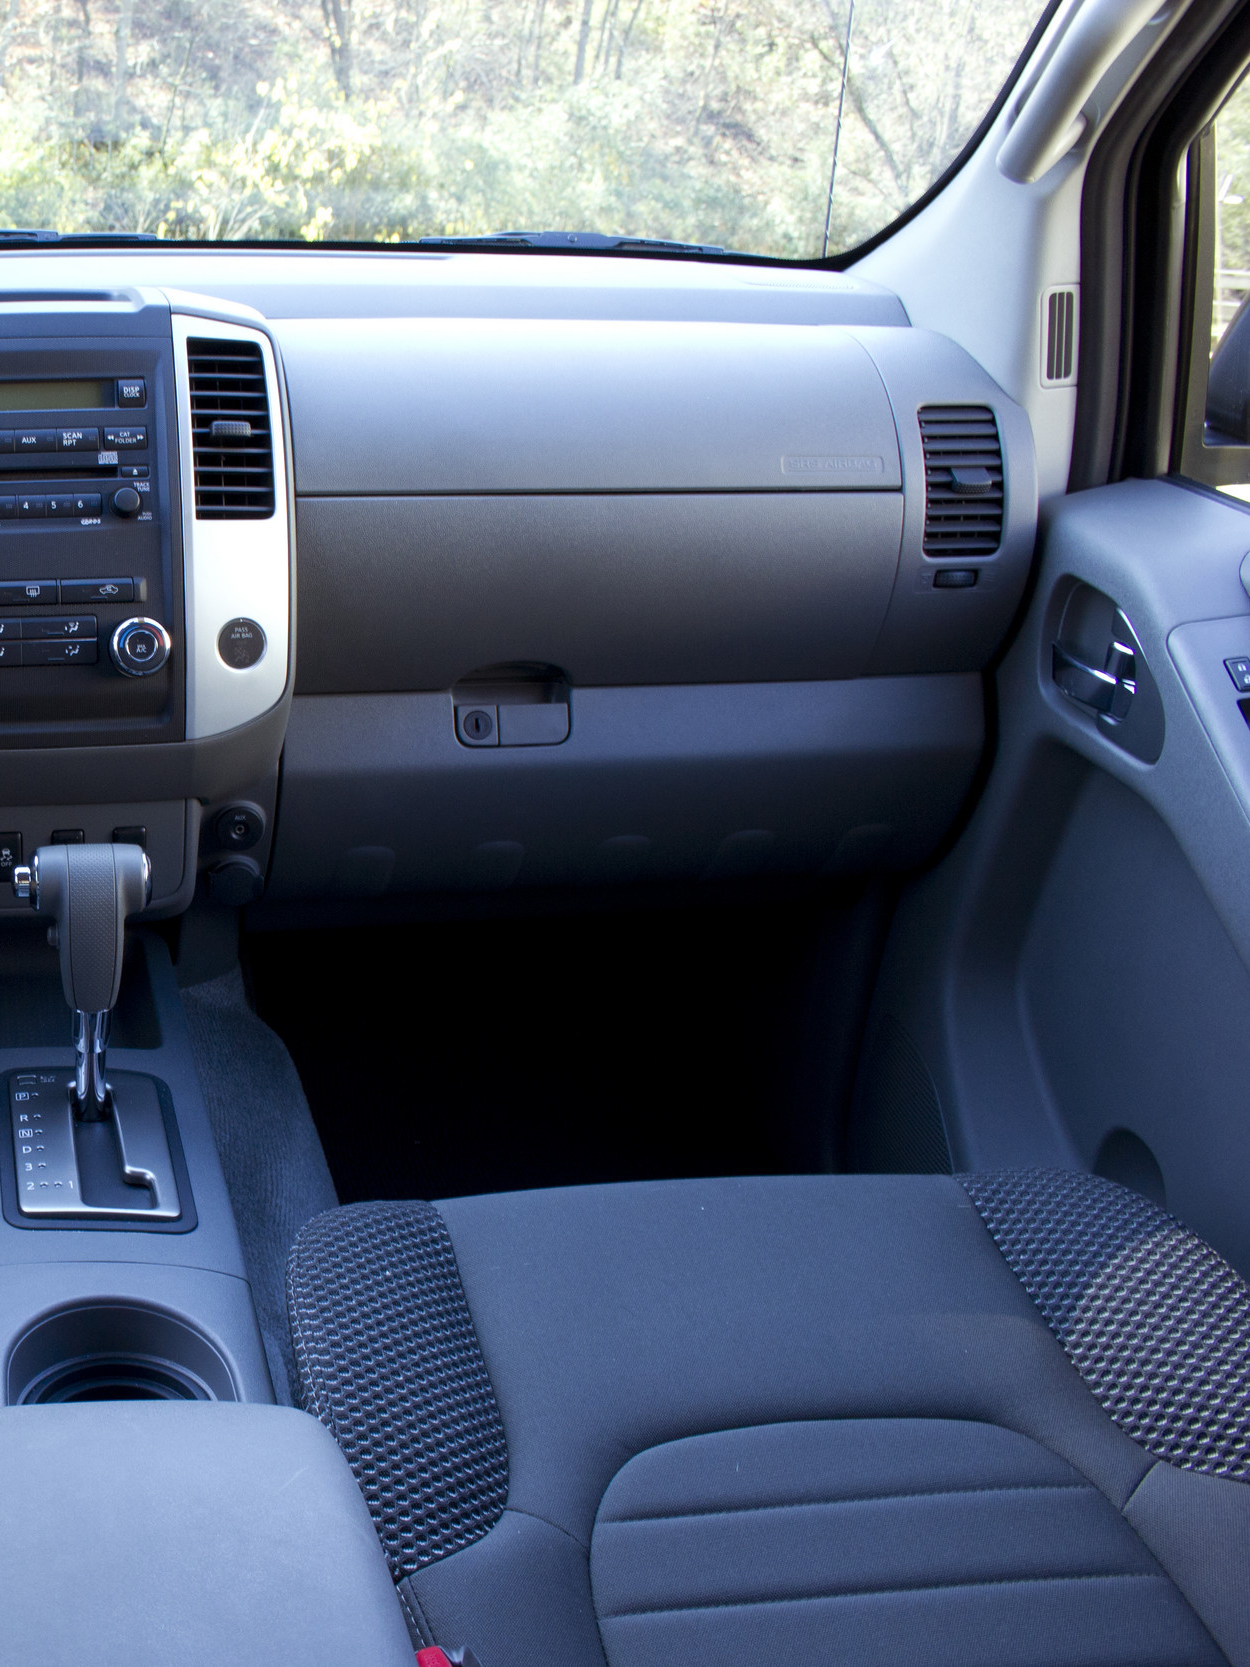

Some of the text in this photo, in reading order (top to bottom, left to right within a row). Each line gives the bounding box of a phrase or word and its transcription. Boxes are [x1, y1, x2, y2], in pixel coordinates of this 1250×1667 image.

[123, 386, 140, 394] DISP
[62, 432, 83, 440] SCAN
[23, 501, 29, 509] 4
[51, 501, 57, 509] 5
[78, 500, 84, 509] 6
[20, 1114, 29, 1122] R
[25, 1163, 33, 1171] 3
[27, 1181, 74, 1190] 2 1
